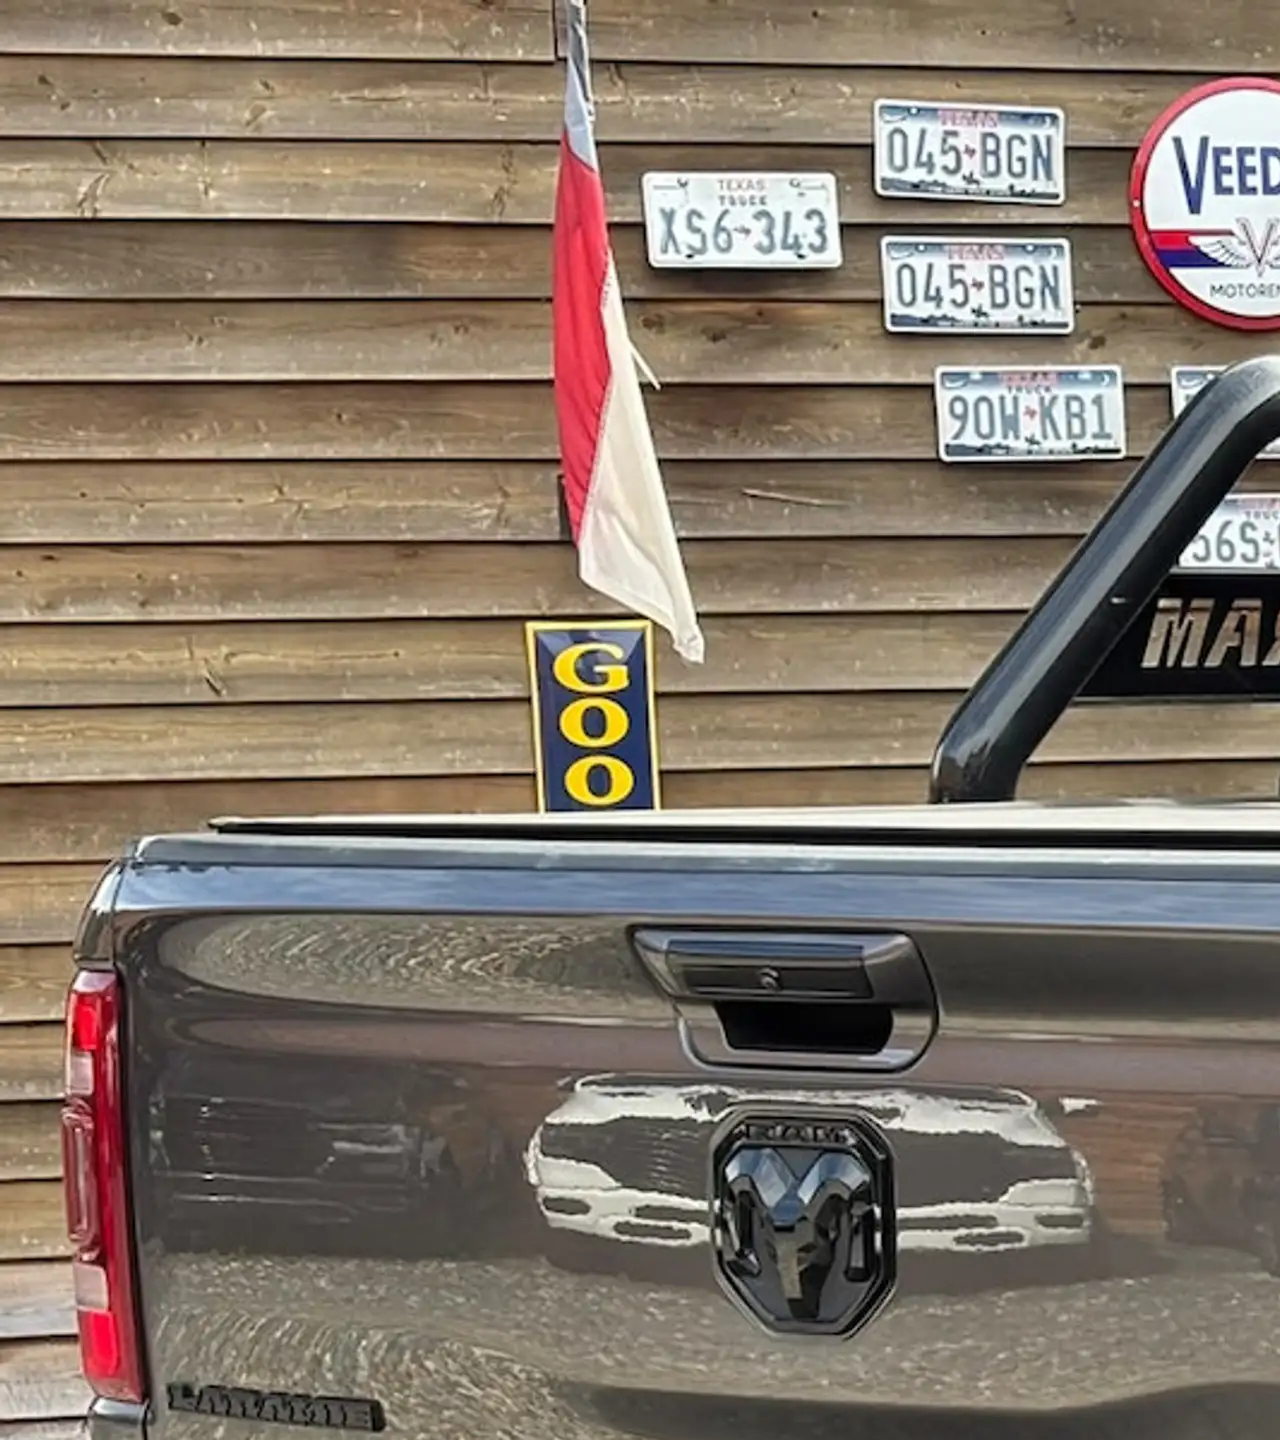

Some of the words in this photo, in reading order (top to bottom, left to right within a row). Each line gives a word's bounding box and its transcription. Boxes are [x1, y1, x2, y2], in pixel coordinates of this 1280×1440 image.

[887, 128, 962, 176] 045
[978, 132, 1054, 181] BGN
[717, 179, 767, 191] TEXAS
[659, 208, 734, 255] XS6
[752, 208, 828, 255] 343
[896, 262, 970, 308] 045
[987, 264, 1062, 311] BGN
[1039, 394, 1114, 441] KB1
